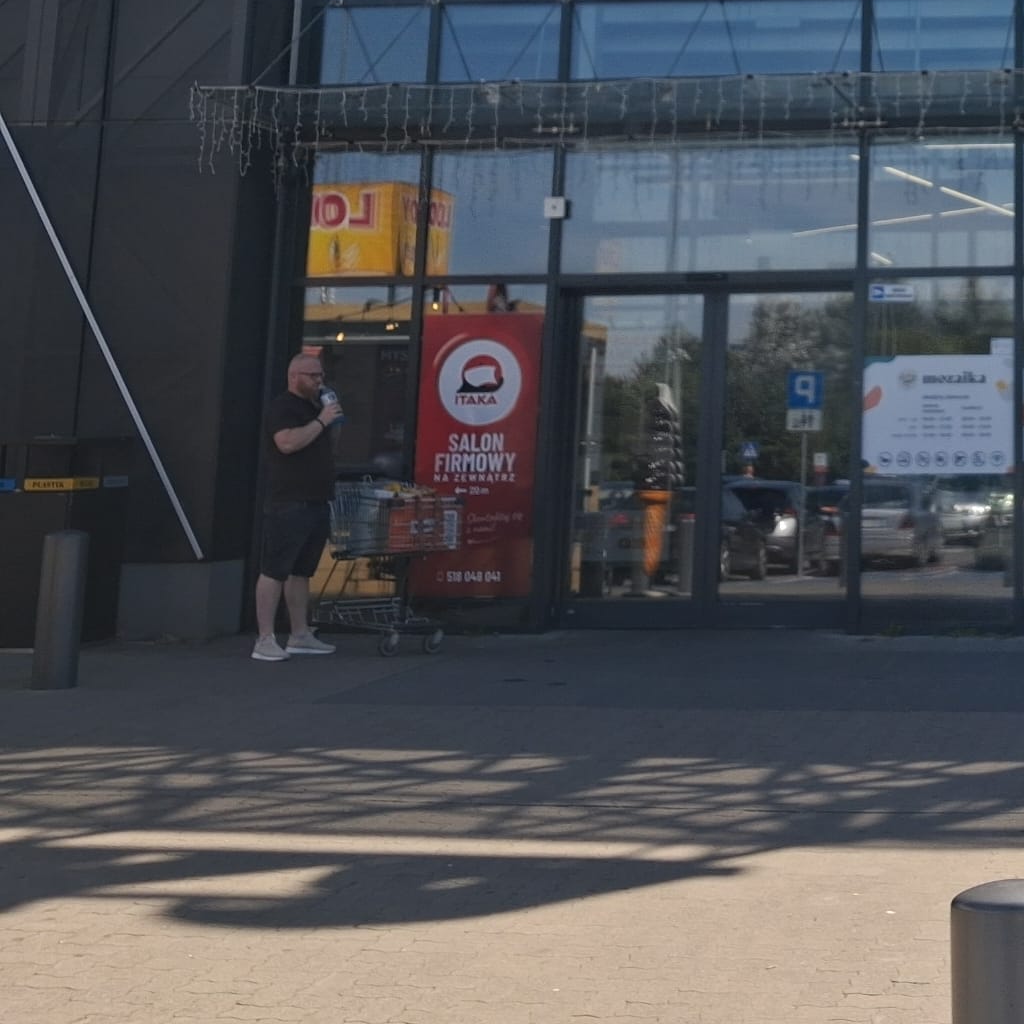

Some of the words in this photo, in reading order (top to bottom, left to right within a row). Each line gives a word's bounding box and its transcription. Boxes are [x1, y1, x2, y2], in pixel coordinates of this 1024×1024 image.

[455, 394, 497, 405] ITAKA
[448, 432, 505, 452] SALON
[434, 452, 517, 473] FIRMOWY
